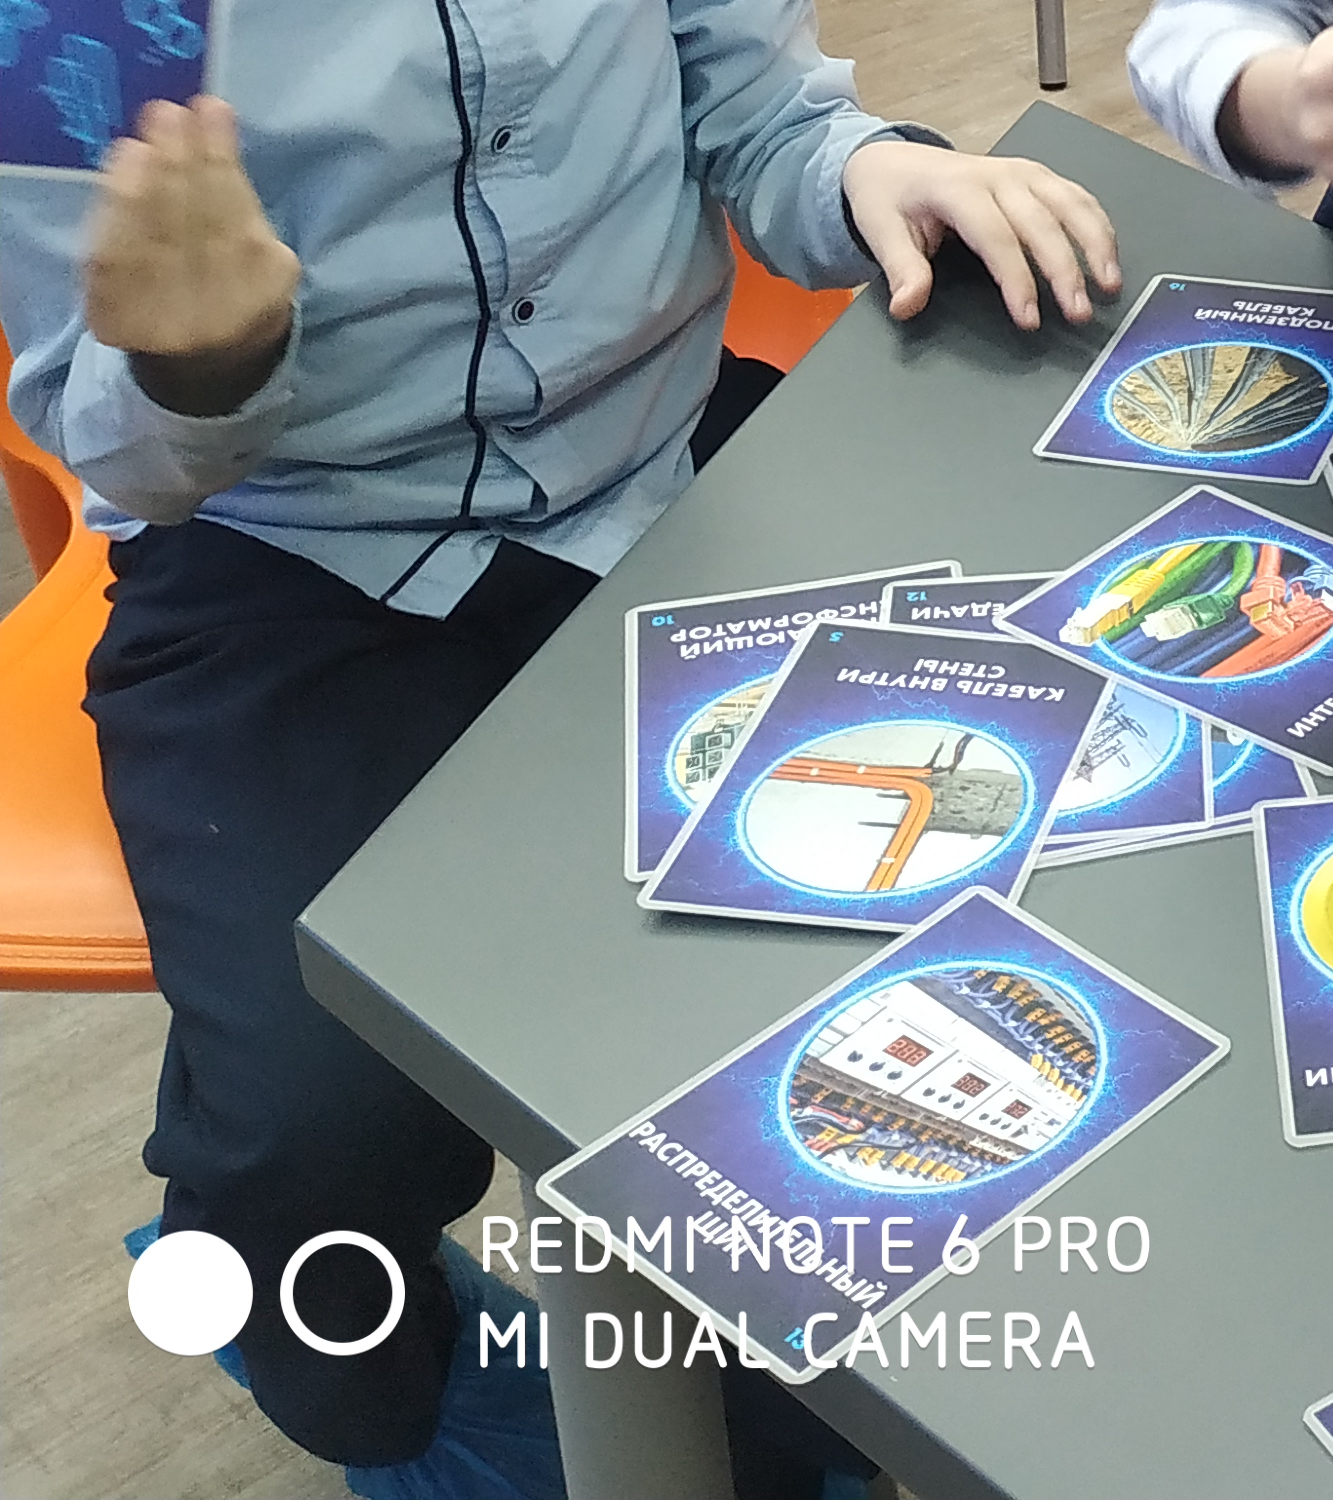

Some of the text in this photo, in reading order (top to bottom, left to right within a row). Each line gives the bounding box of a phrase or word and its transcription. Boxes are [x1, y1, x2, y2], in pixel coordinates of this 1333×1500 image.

[1232, 300, 1317, 317] КАБЕЛЬ
[651, 614, 675, 627] 10
[669, 599, 883, 643] НСФОРМАТОР
[828, 631, 844, 643] 5
[913, 658, 1006, 679] СТЕНЫ
[836, 668, 1066, 702] КАБЕЛЬ ВНУТРИ
[628, 1120, 889, 1310] РАСПРЕДЕЛИТЕЛЬНЫЙ
